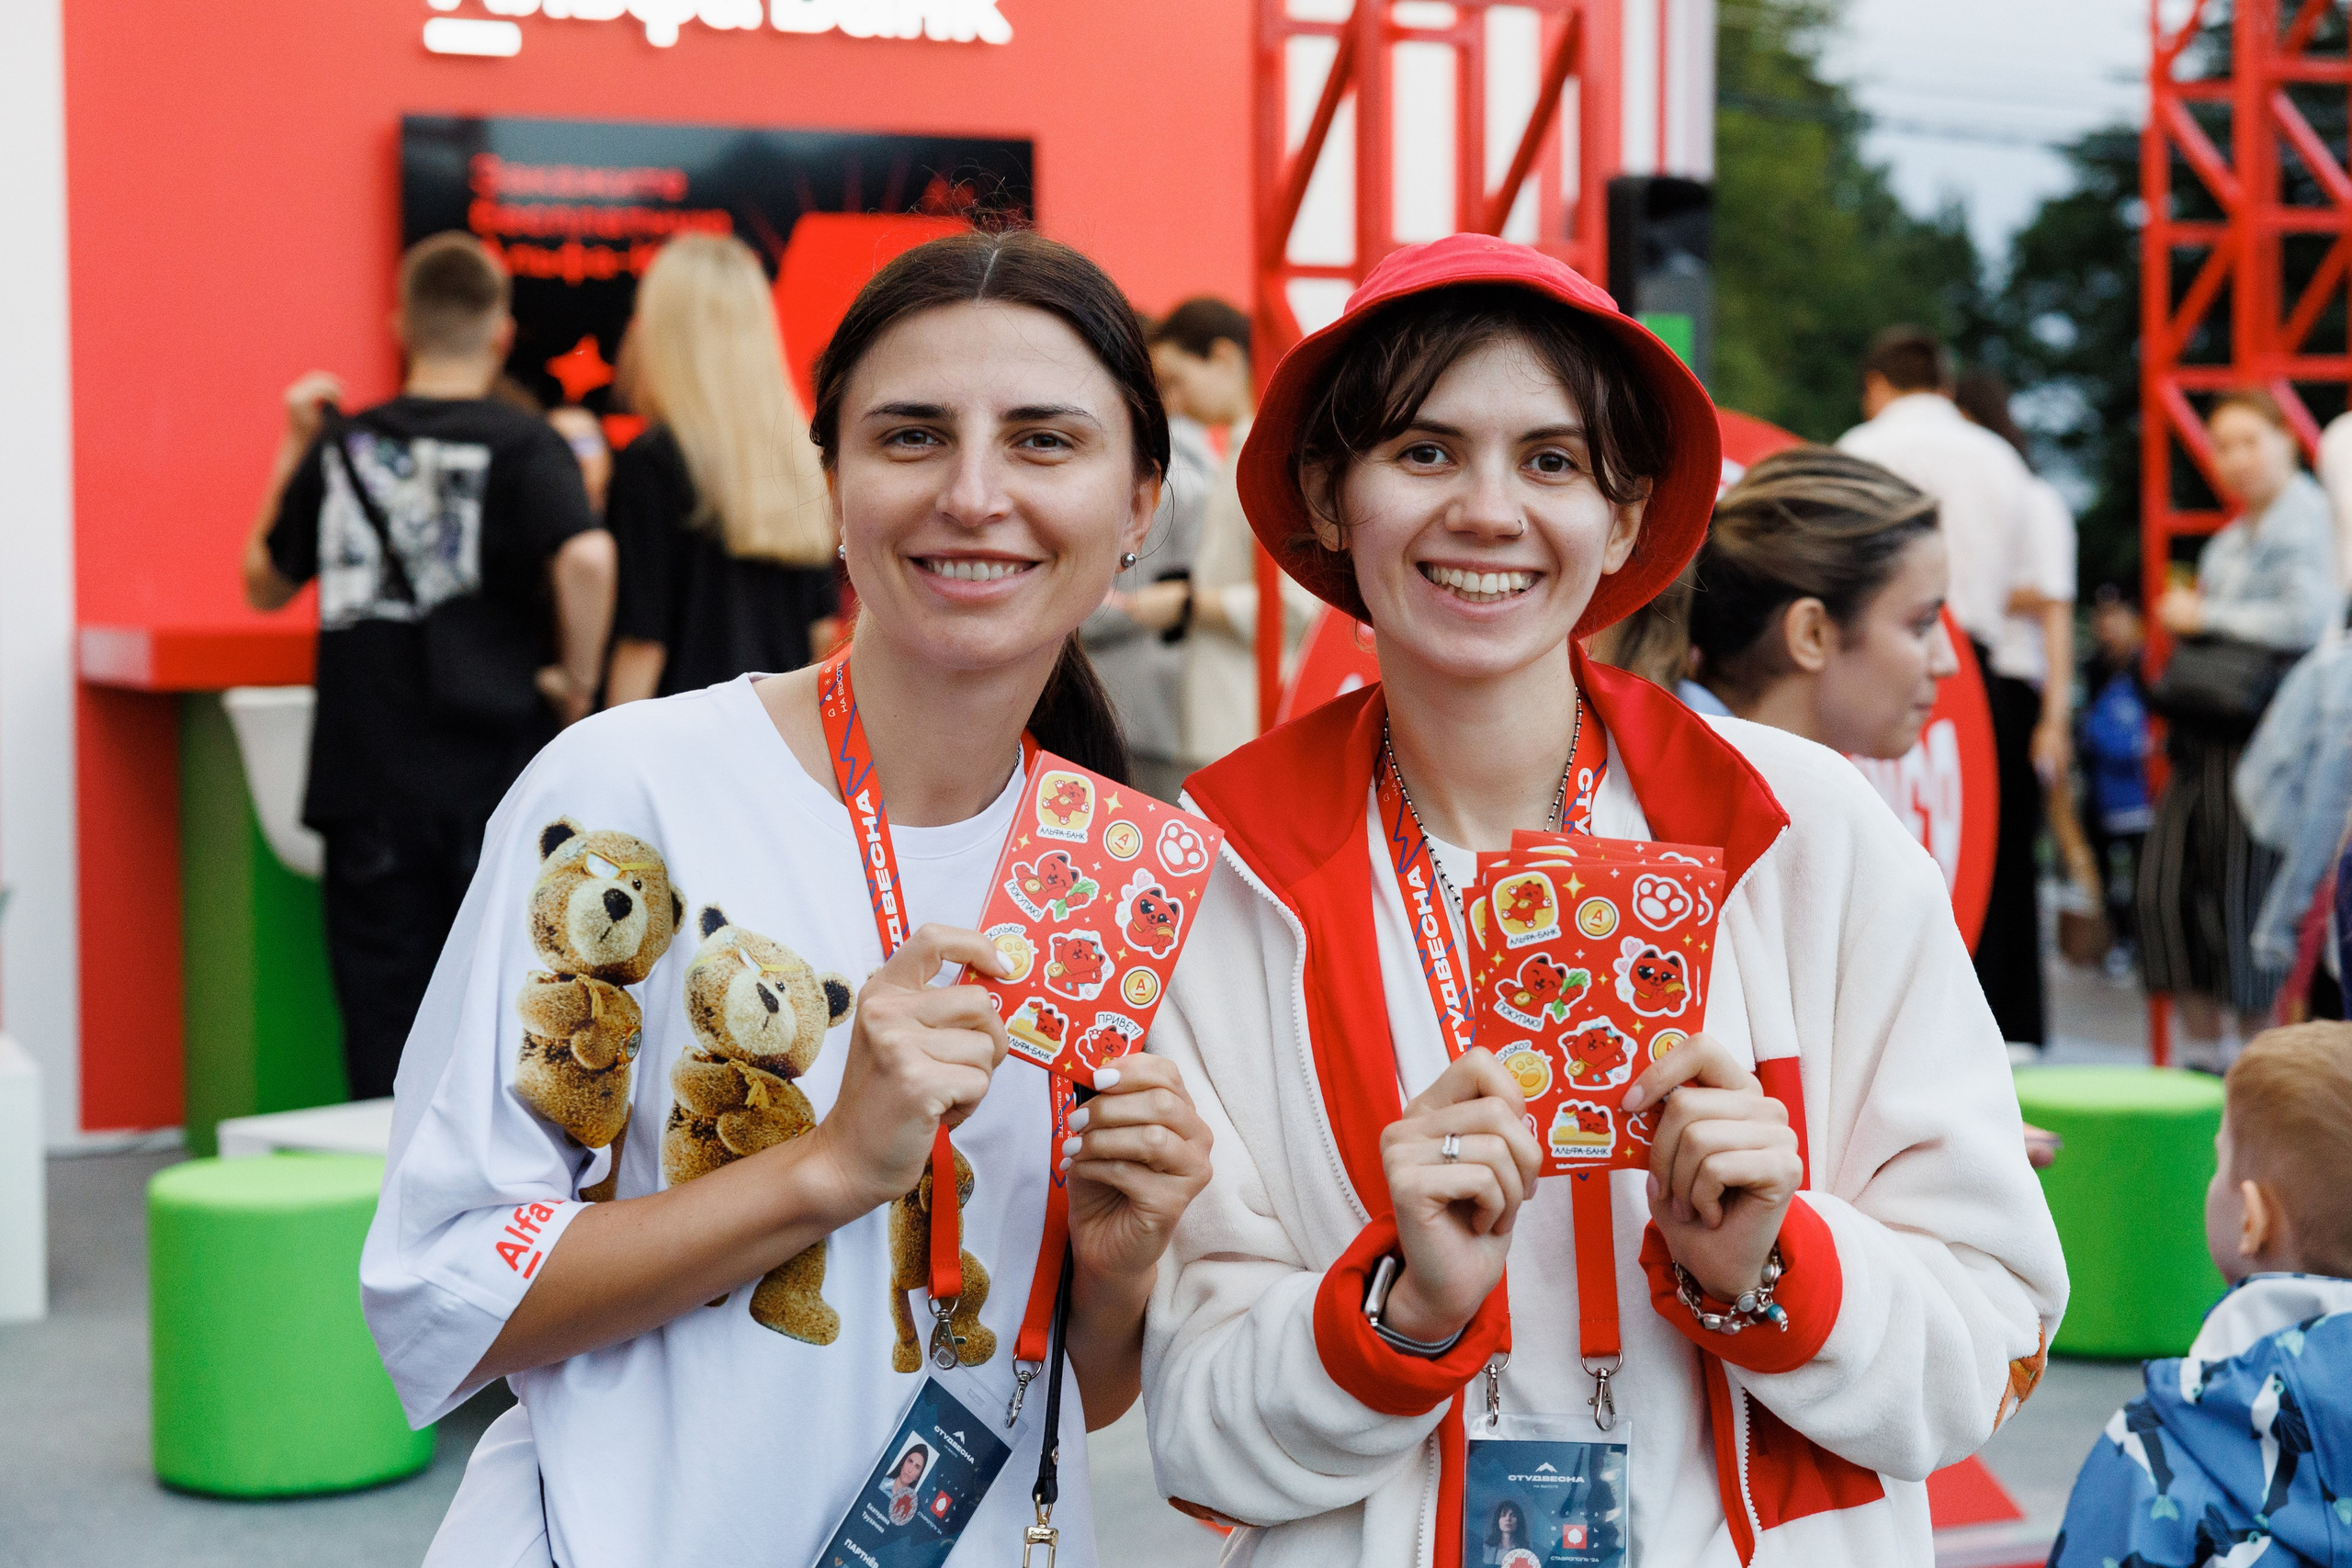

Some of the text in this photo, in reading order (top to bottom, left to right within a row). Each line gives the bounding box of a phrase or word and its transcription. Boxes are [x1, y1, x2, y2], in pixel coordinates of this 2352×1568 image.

[1039, 827, 1085, 840] АЛЬФА-БАНК
[987, 925, 1024, 939] КОЛЬКО?
[1509, 928, 1558, 945] АЛЬФА-БАНК
[1407, 864, 1472, 1054] ТУДВЕСНА
[1097, 1013, 1142, 1037] ПРИВЕТ!
[1555, 1147, 1609, 1156] АЛЬФА-БАНК
[496, 1202, 555, 1274] Alfa
[933, 1425, 975, 1464] СТУДВЕСНА
[1508, 1474, 1586, 1483] СТУДВЕСНА
